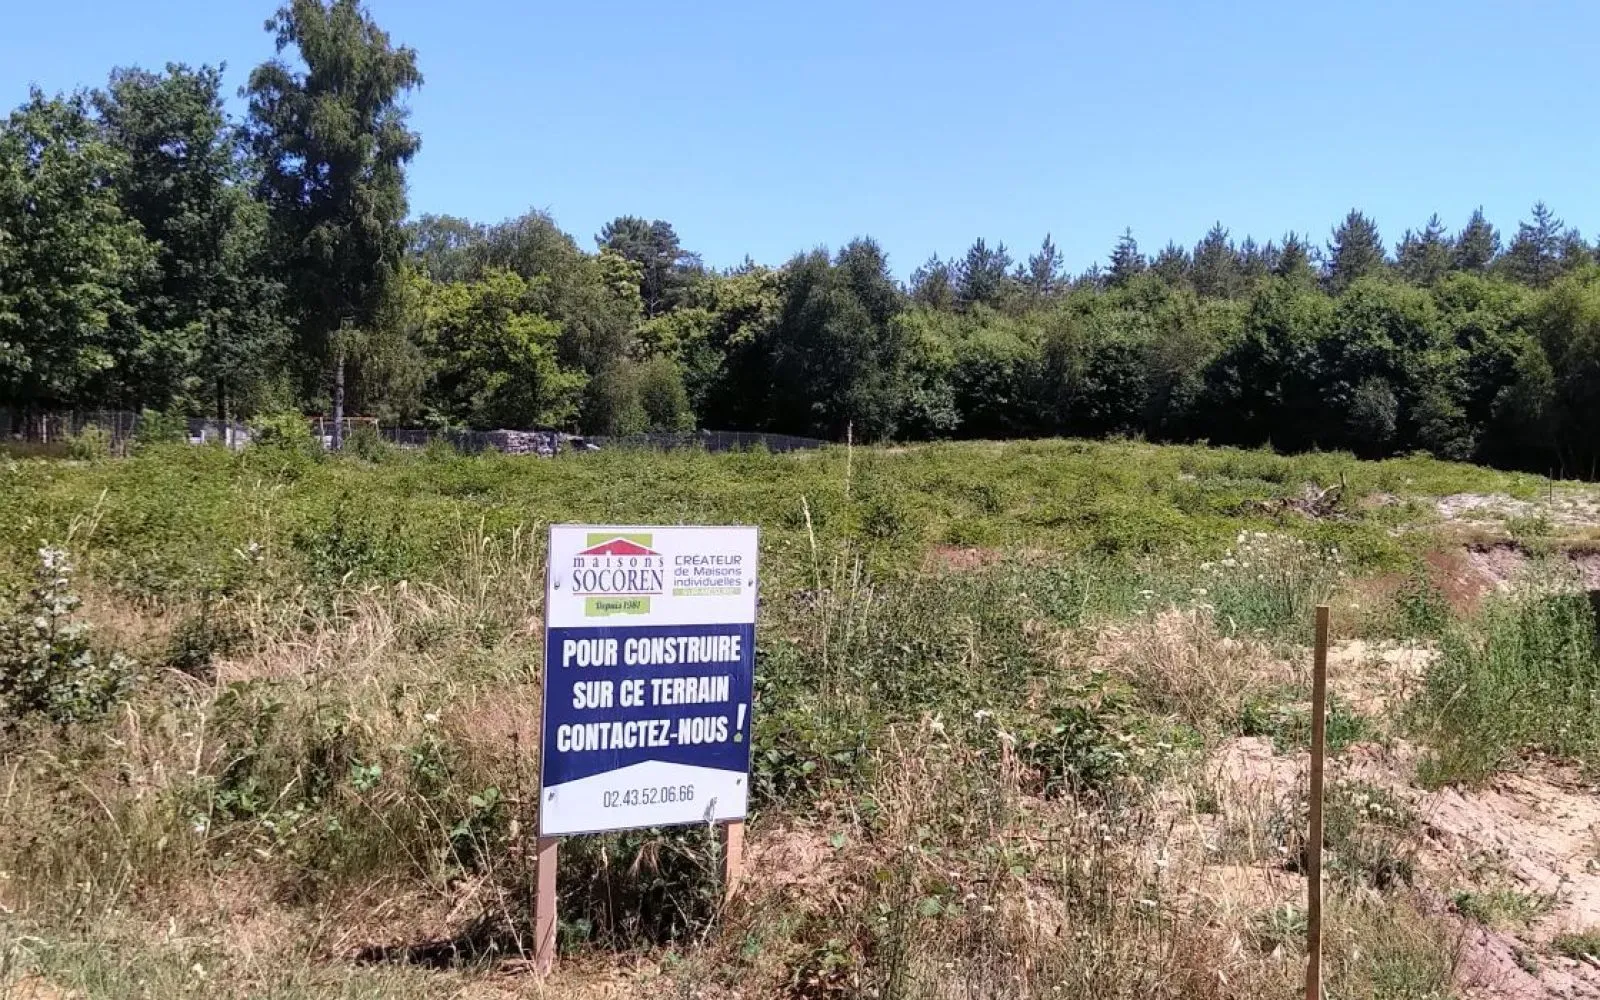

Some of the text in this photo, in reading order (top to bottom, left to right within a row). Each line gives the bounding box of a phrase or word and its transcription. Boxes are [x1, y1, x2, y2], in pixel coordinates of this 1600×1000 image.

[573, 557, 664, 568] maisons
[674, 566, 742, 577] de Maisons
[572, 569, 664, 592] SOCOREN
[673, 577, 742, 587] individuelles
[562, 635, 741, 668] POUR CONSTRUIRE
[572, 676, 730, 710] SUR CE TERRAIN
[556, 703, 747, 752] CONTACTEZ-NOUS !
[603, 784, 695, 808] 02.43.52.06.66
